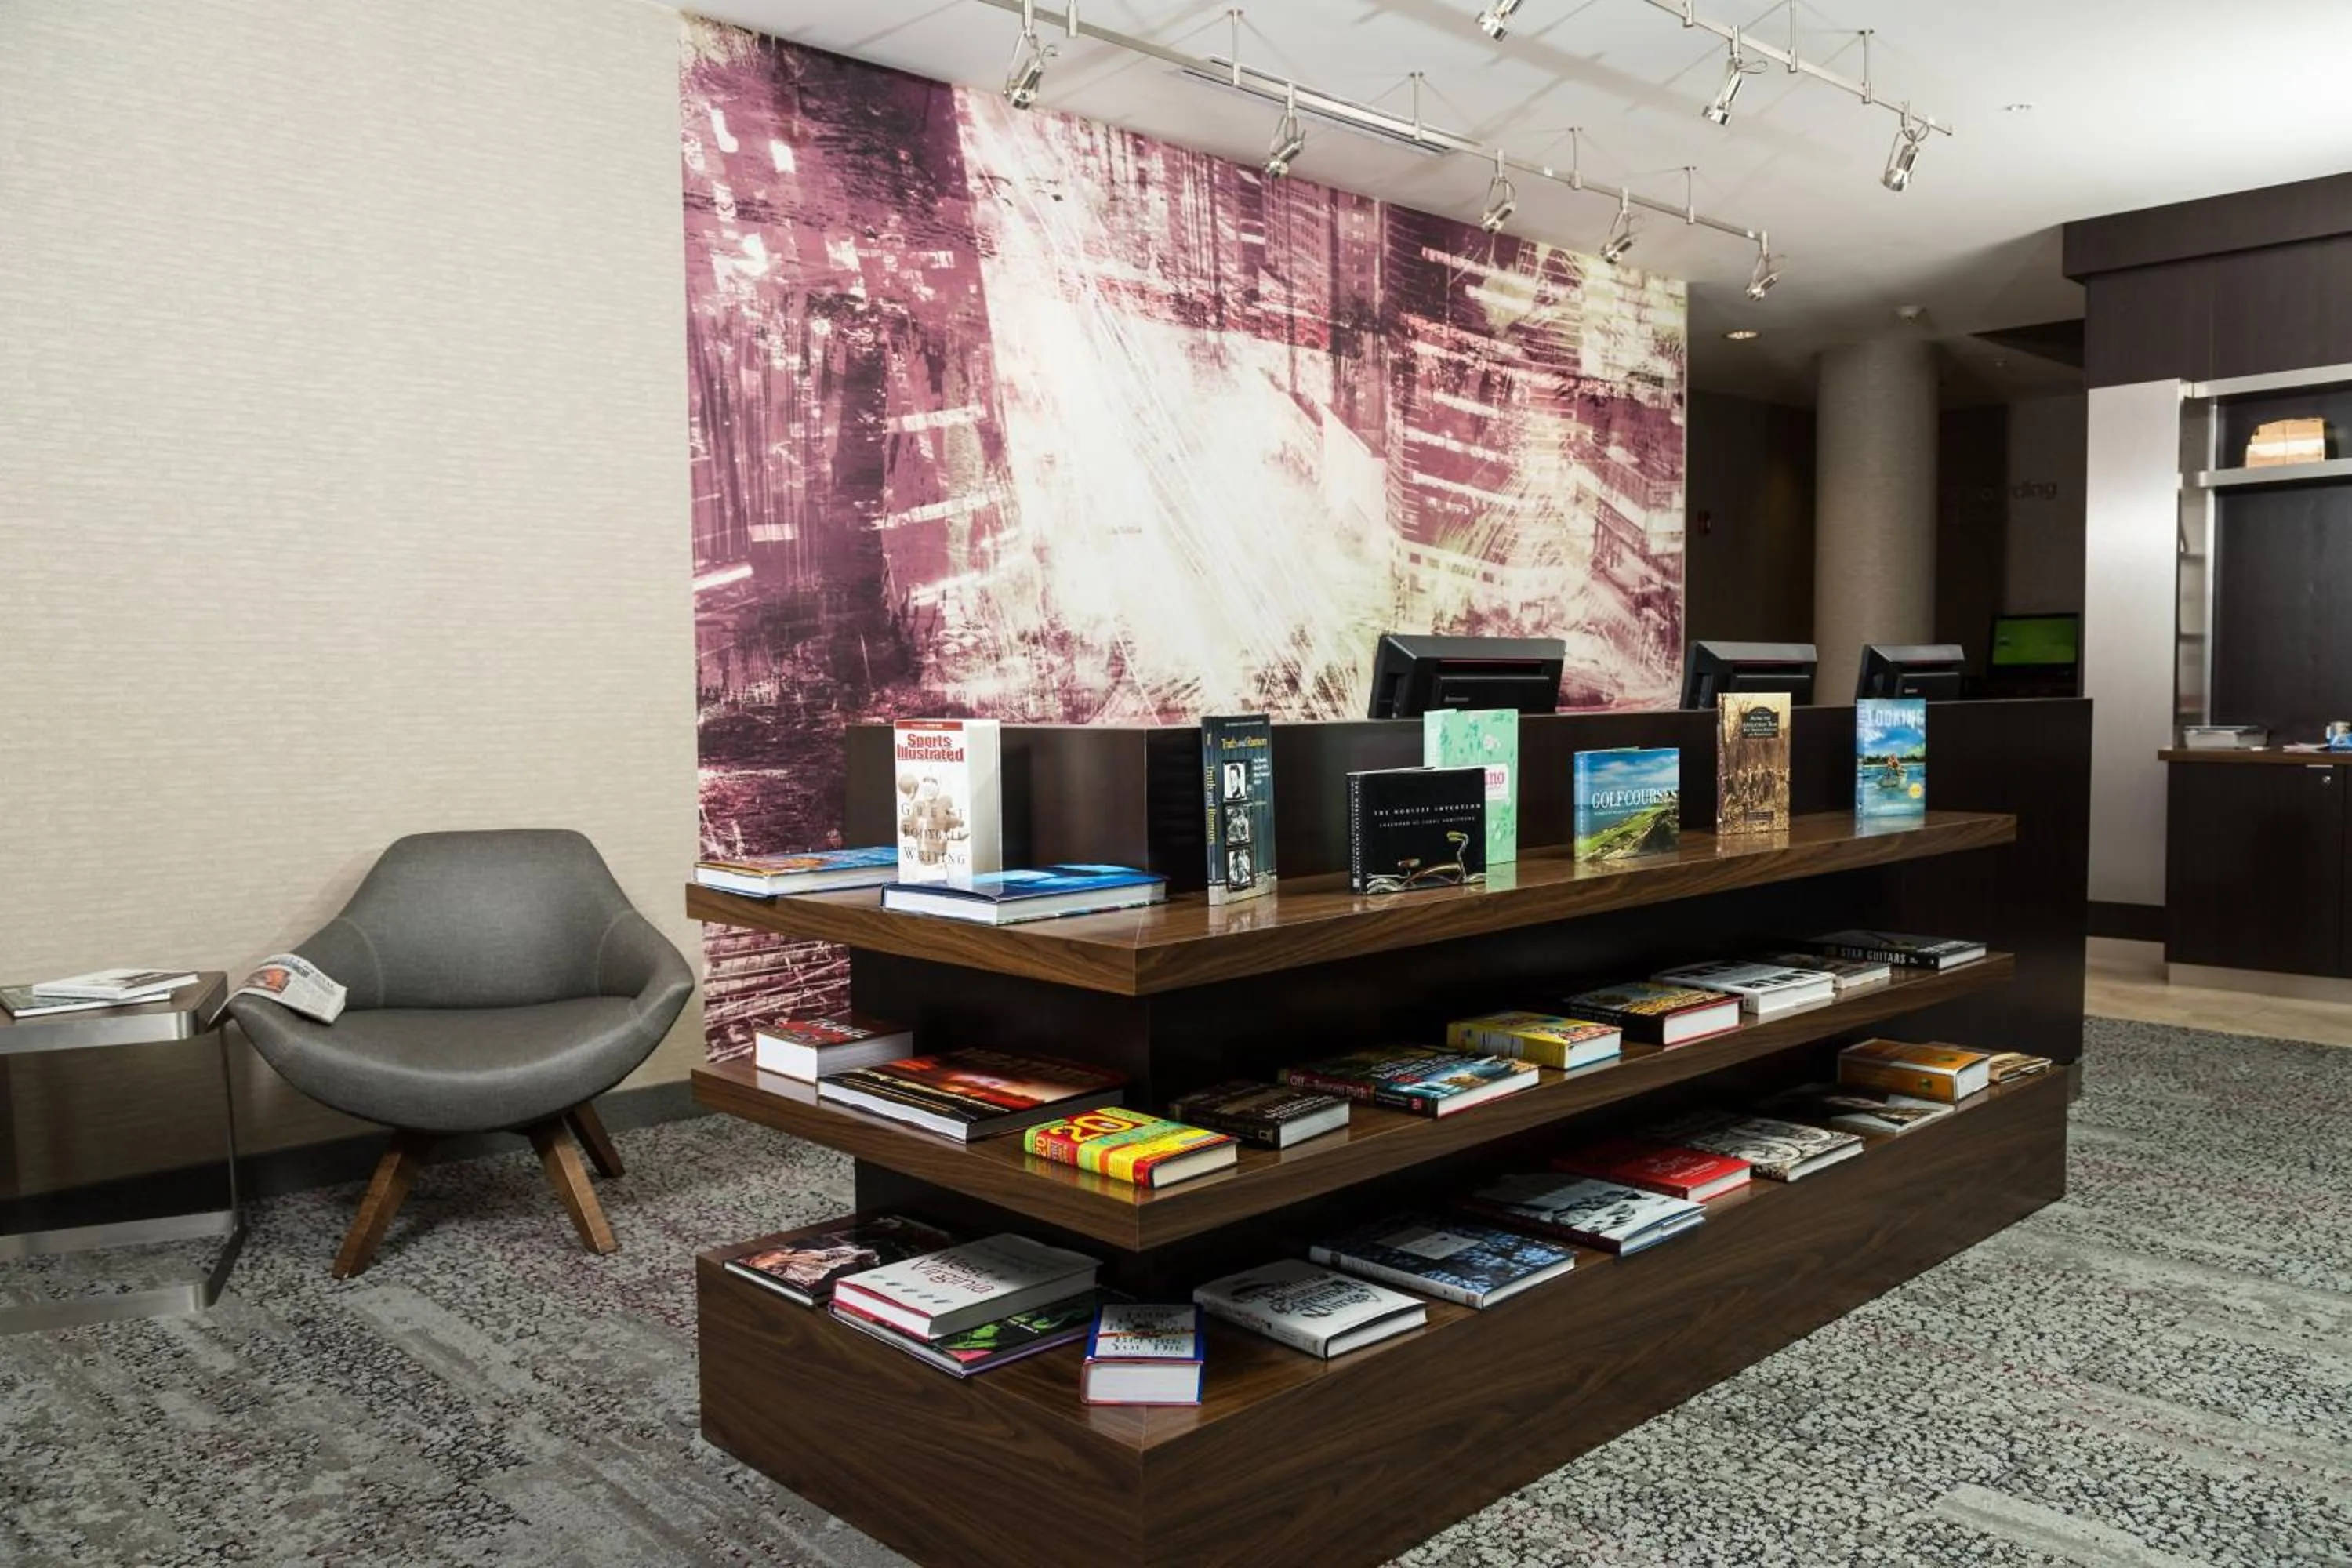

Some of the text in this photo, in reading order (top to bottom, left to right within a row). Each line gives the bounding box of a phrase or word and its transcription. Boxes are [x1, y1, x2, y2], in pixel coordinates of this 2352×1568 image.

[1868, 708, 1925, 728] LOOKING
[907, 733, 953, 748] Sports
[897, 744, 964, 762] Illustrated
[1867, 949, 1907, 965] GUITARS
